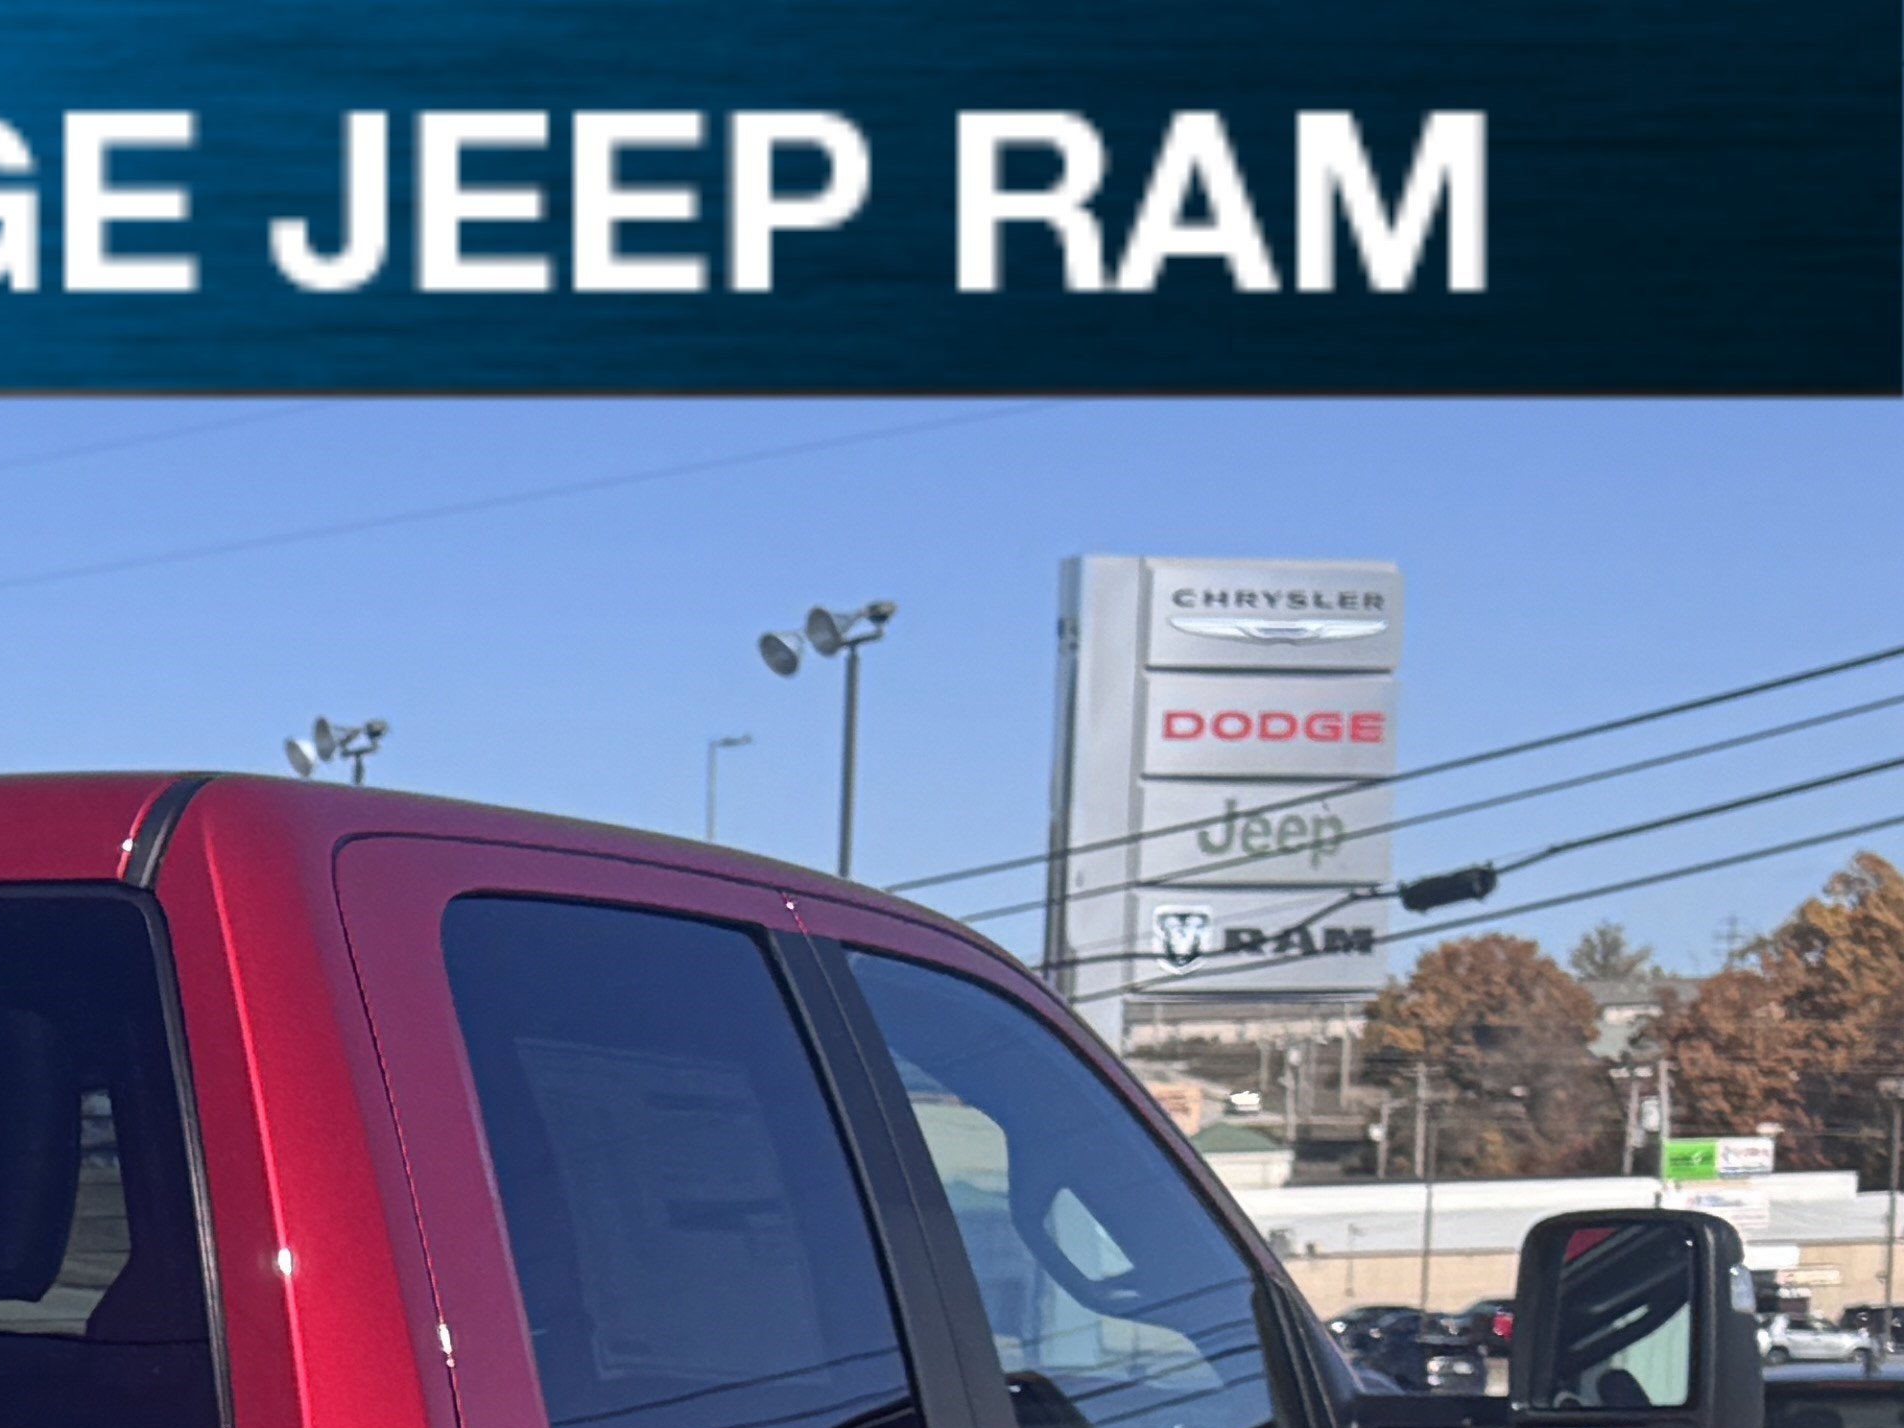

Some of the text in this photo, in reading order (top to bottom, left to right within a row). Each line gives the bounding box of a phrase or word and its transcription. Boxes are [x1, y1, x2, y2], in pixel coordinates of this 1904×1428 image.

[1172, 588, 1386, 610] CHRYSLER
[1162, 710, 1386, 743] DODGE
[1197, 799, 1347, 869] Jeep
[1223, 927, 1375, 956] RAM
